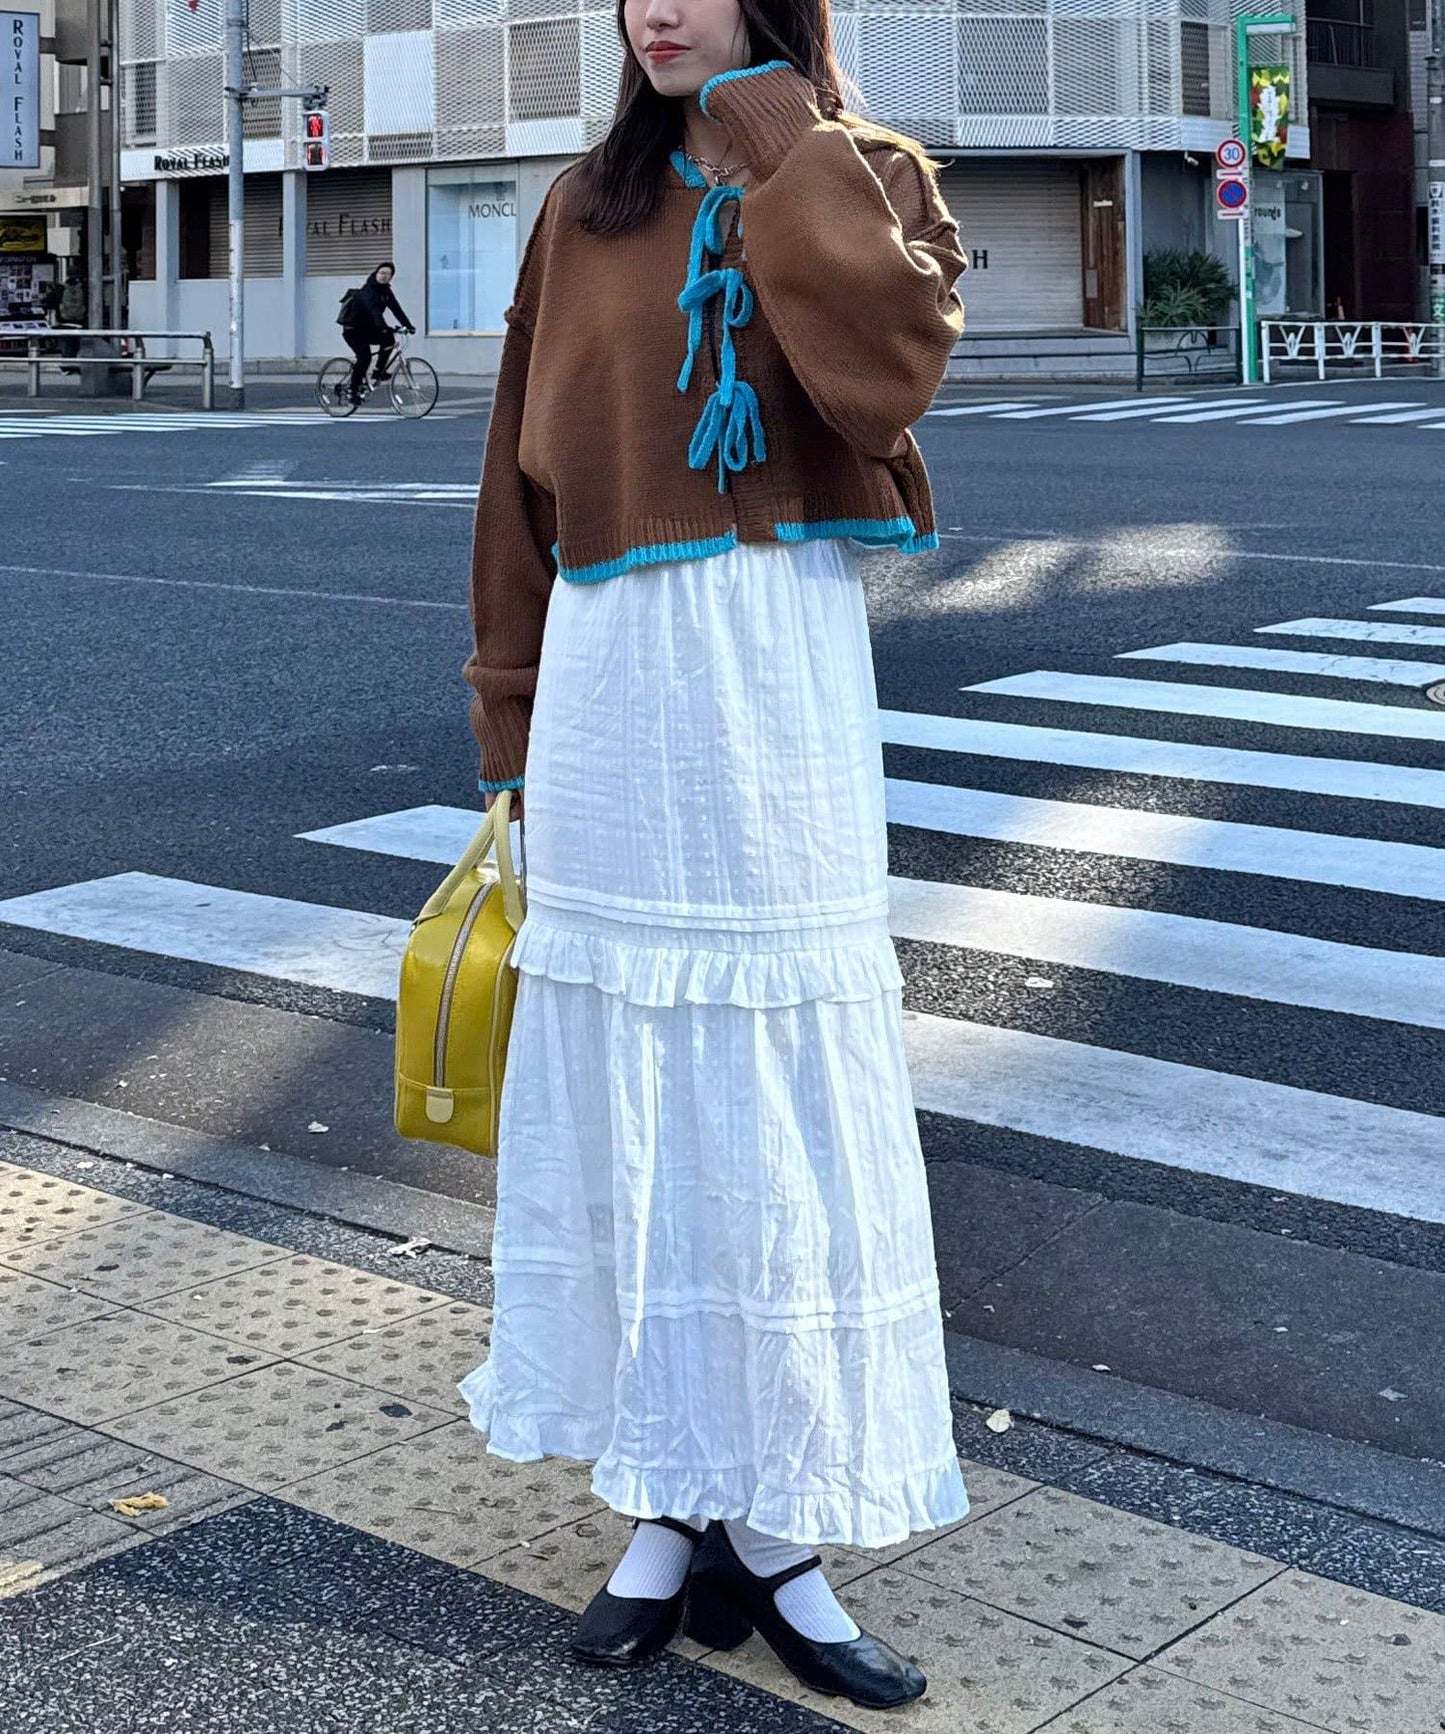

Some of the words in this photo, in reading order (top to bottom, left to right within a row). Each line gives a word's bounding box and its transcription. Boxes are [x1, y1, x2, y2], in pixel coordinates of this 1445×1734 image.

[13, 20, 23, 85] ROYAL
[14, 97, 23, 160] FLASH
[154, 155, 188, 171] ROYAL
[194, 153, 229, 170] FLASH
[1223, 147, 1240, 161] 30
[468, 202, 516, 218] MONCL
[339, 213, 391, 235] FLASH
